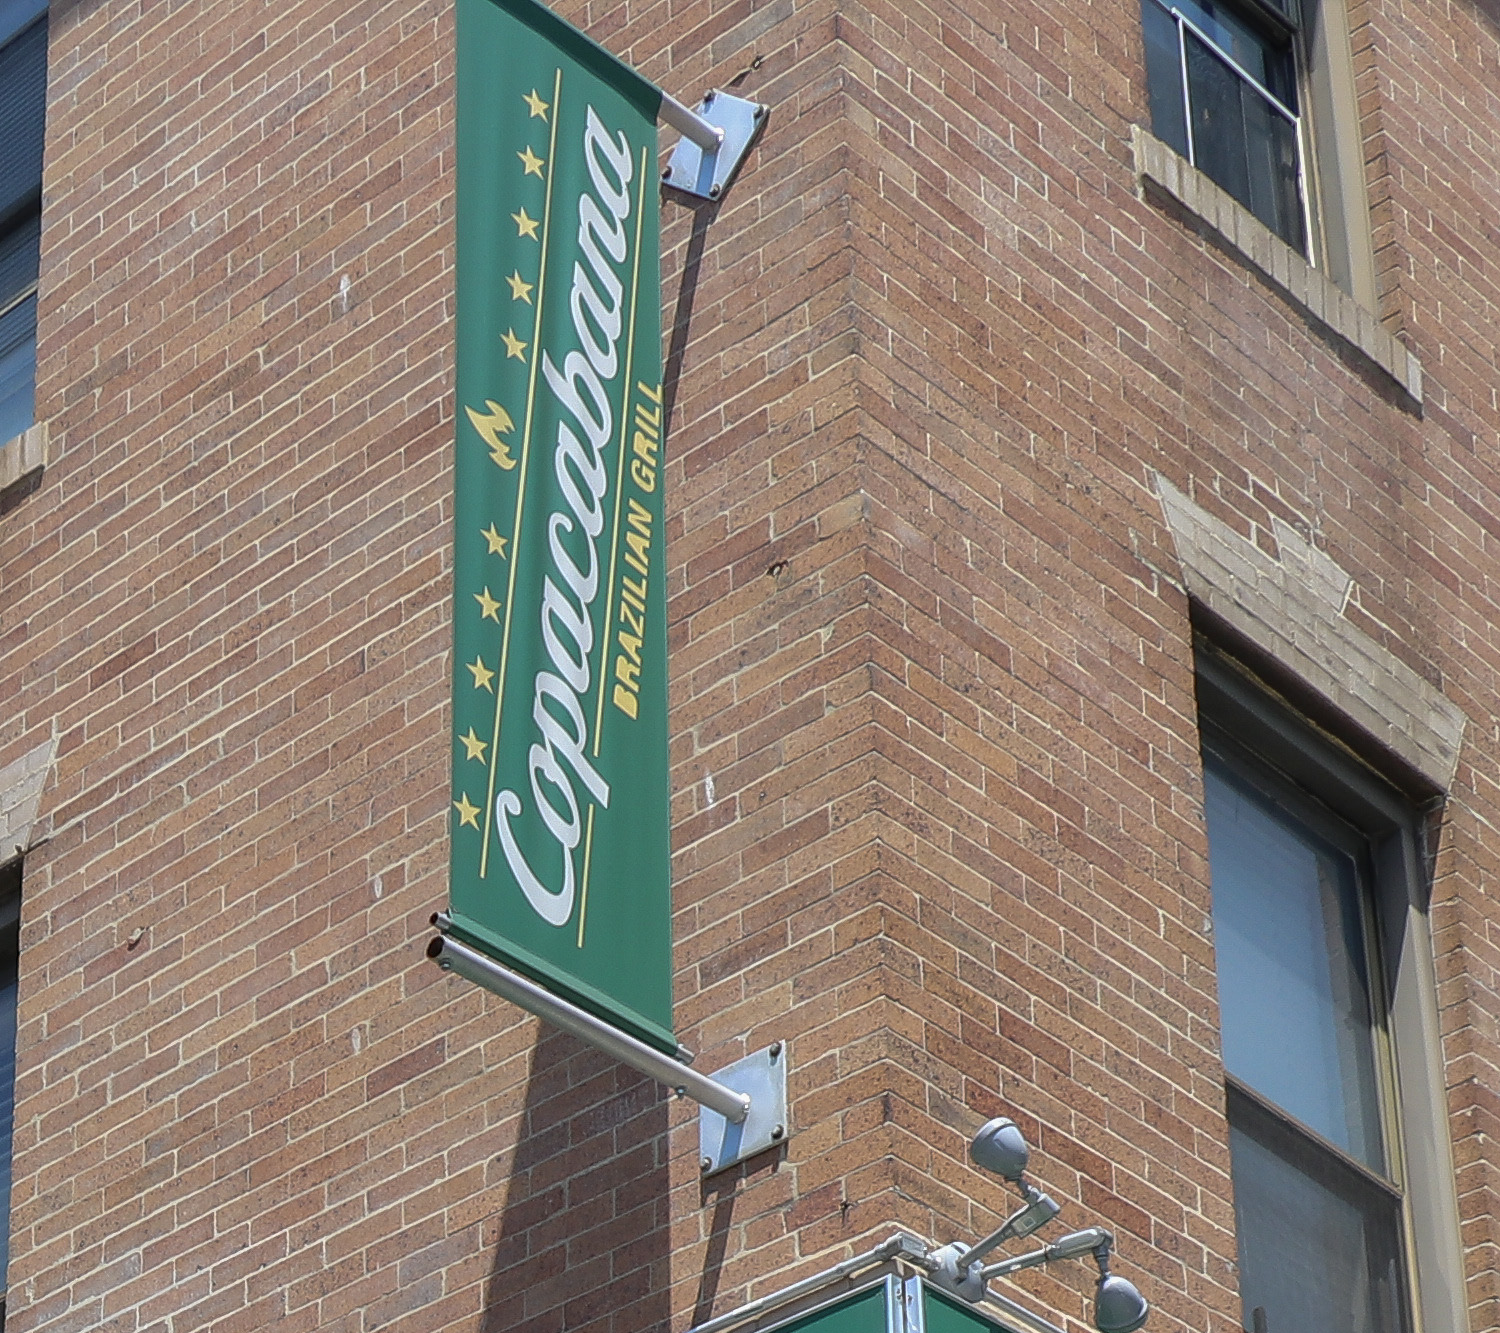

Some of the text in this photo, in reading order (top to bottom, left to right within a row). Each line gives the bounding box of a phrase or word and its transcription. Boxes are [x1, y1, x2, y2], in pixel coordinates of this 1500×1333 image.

[496, 104, 634, 928] Copacabana
[613, 380, 664, 721] BRAZILIAN GRILL
